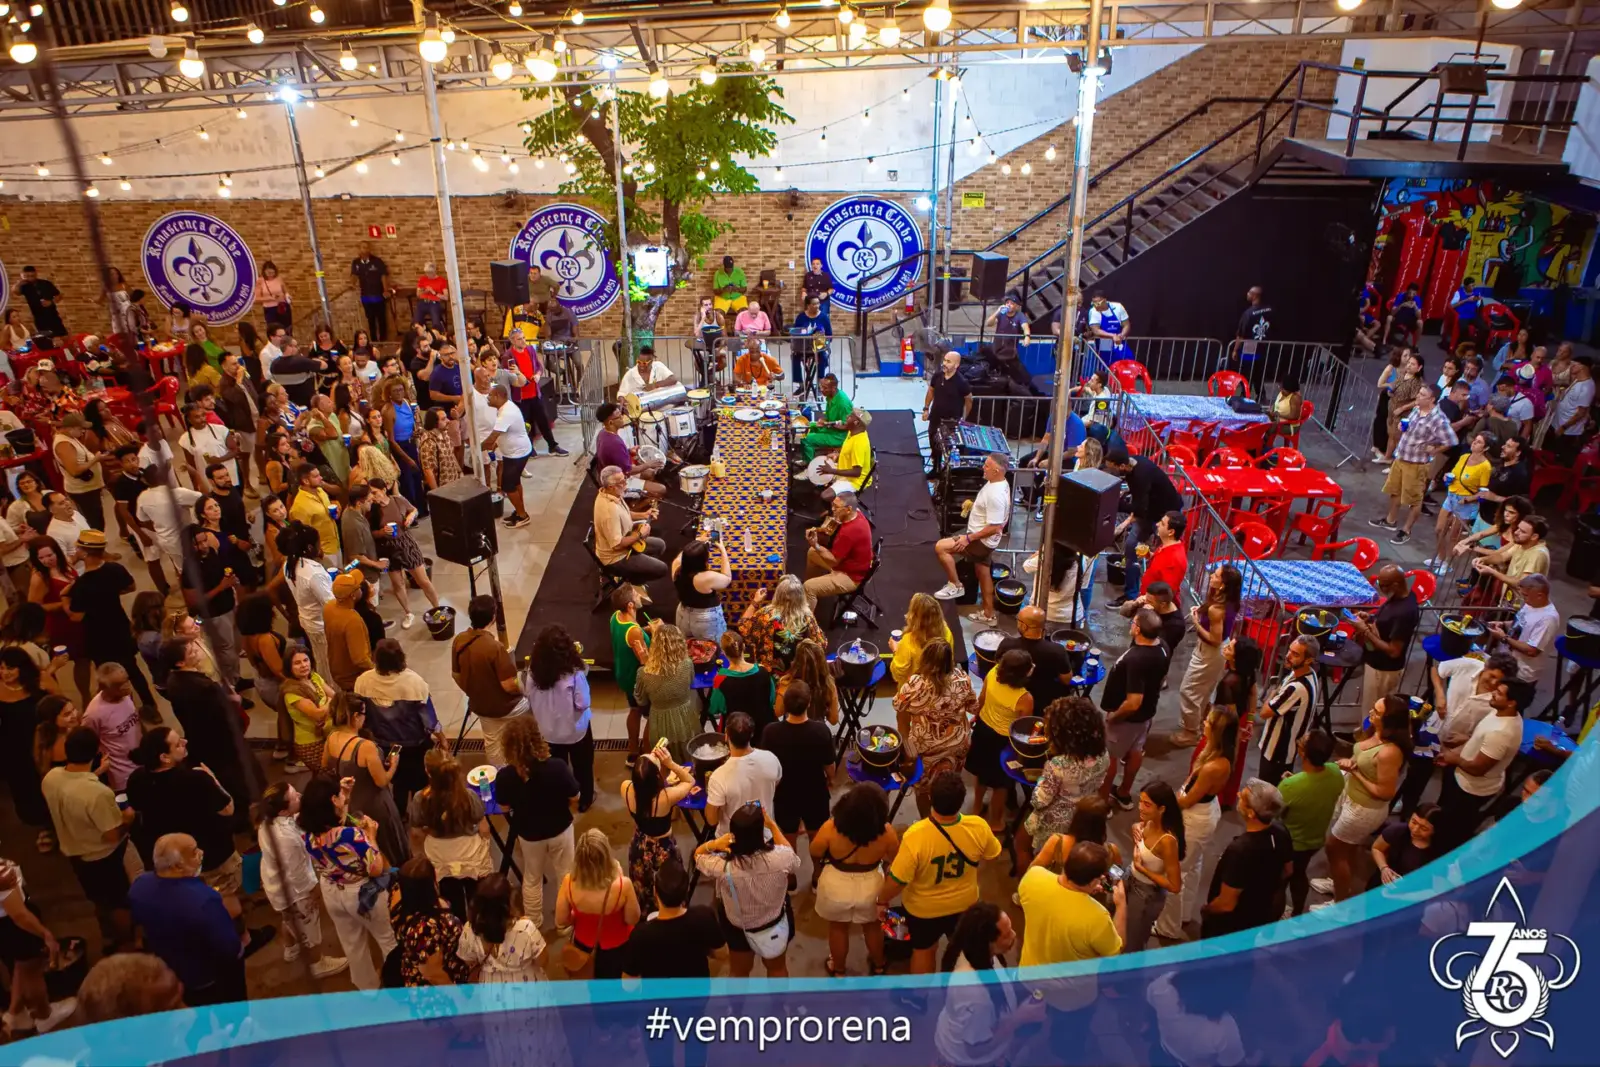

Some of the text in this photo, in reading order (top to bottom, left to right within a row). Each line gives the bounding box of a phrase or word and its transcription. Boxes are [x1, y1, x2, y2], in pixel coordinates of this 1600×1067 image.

[147, 219, 241, 259] Renascença Clube
[516, 212, 582, 252] Renascença
[814, 204, 912, 243] Renascença Clube
[604, 278, 616, 293] 1951
[846, 294, 854, 303] 17
[863, 291, 895, 306] Fevereiro
[931, 852, 964, 885] 13
